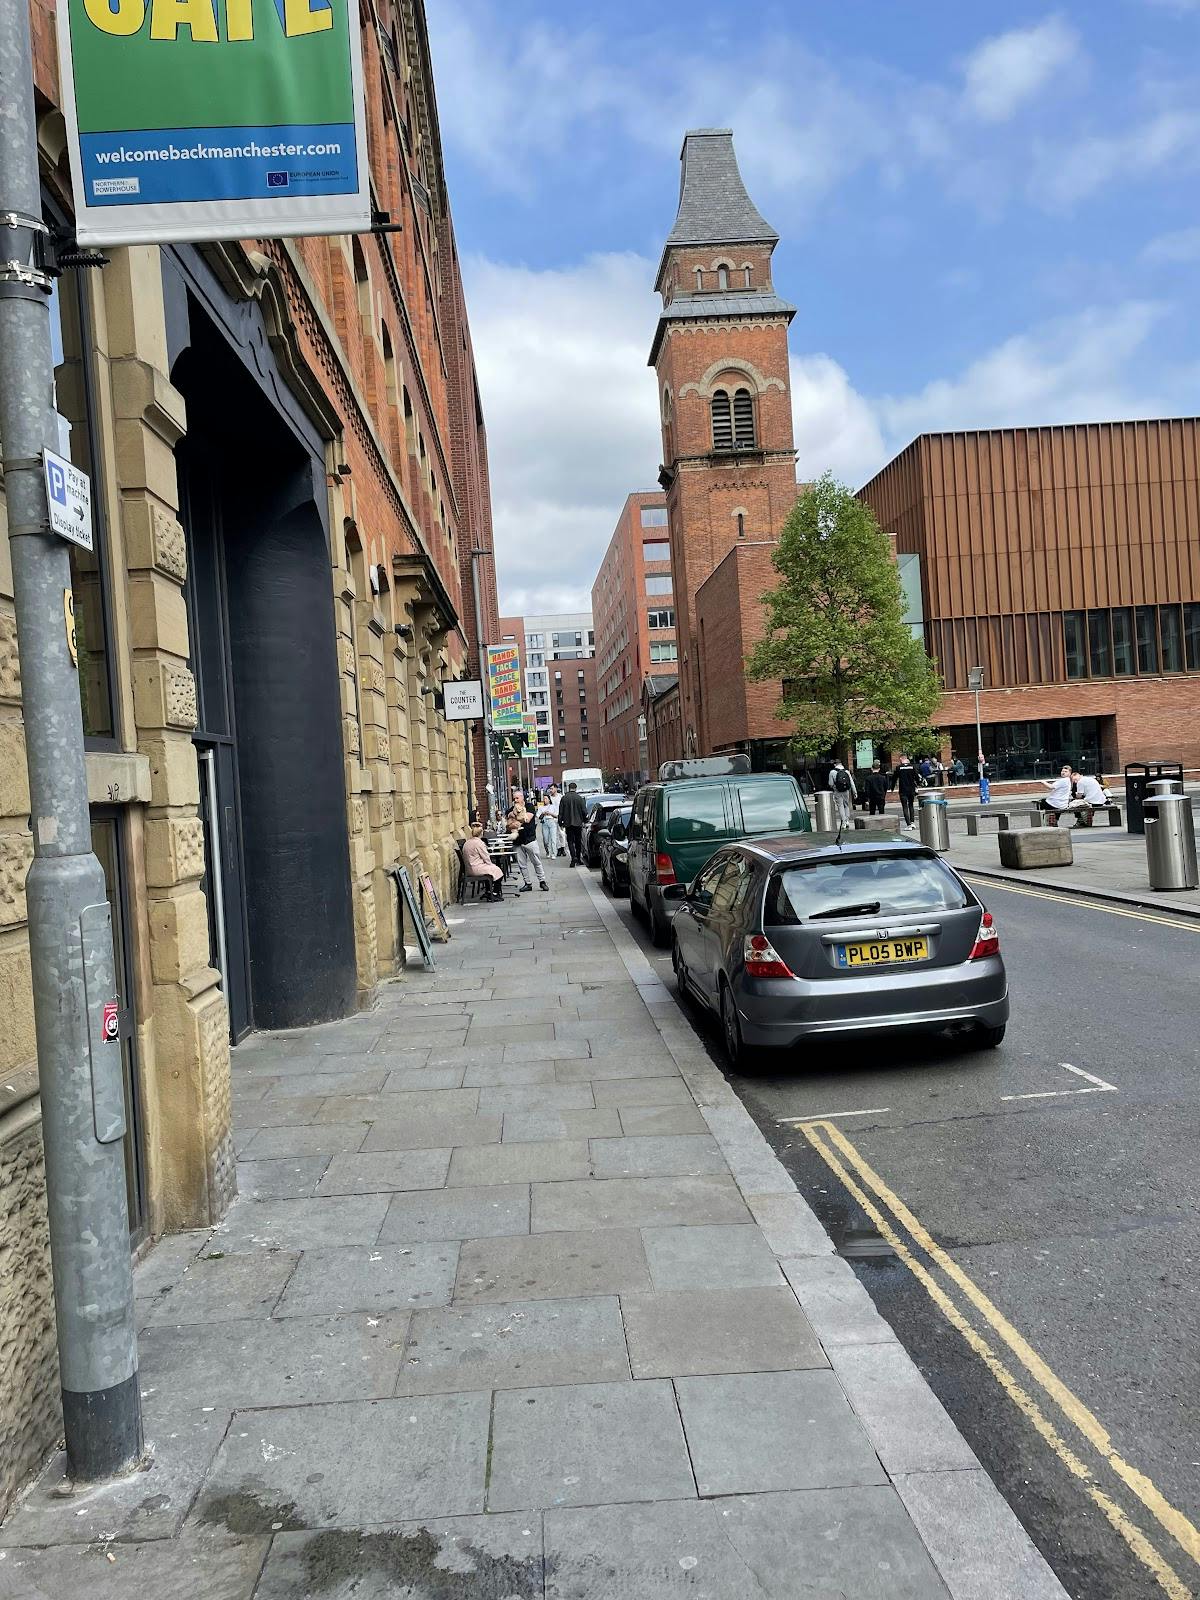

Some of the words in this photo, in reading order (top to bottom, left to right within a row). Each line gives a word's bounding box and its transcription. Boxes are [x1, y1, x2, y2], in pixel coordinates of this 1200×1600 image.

[95, 142, 341, 164] welcomebackmanchester.com
[95, 180, 125, 188] NORTHERN
[95, 185, 137, 193] POWERHOUSE
[52, 466, 63, 497] P
[68, 468, 79, 486] Pay
[79, 478, 86, 490] at
[66, 484, 89, 506] machine
[53, 512, 76, 536] Display
[75, 526, 91, 545] ticket
[492, 650, 515, 662] HANDS
[496, 661, 513, 672] FACE
[494, 672, 516, 684] SPACE
[494, 683, 518, 695] HANDS
[450, 695, 477, 704] COUNTER
[498, 694, 515, 706] FACE
[496, 705, 518, 717] SPACE
[848, 945, 890, 962] PL05
[894, 941, 924, 958] BWP
